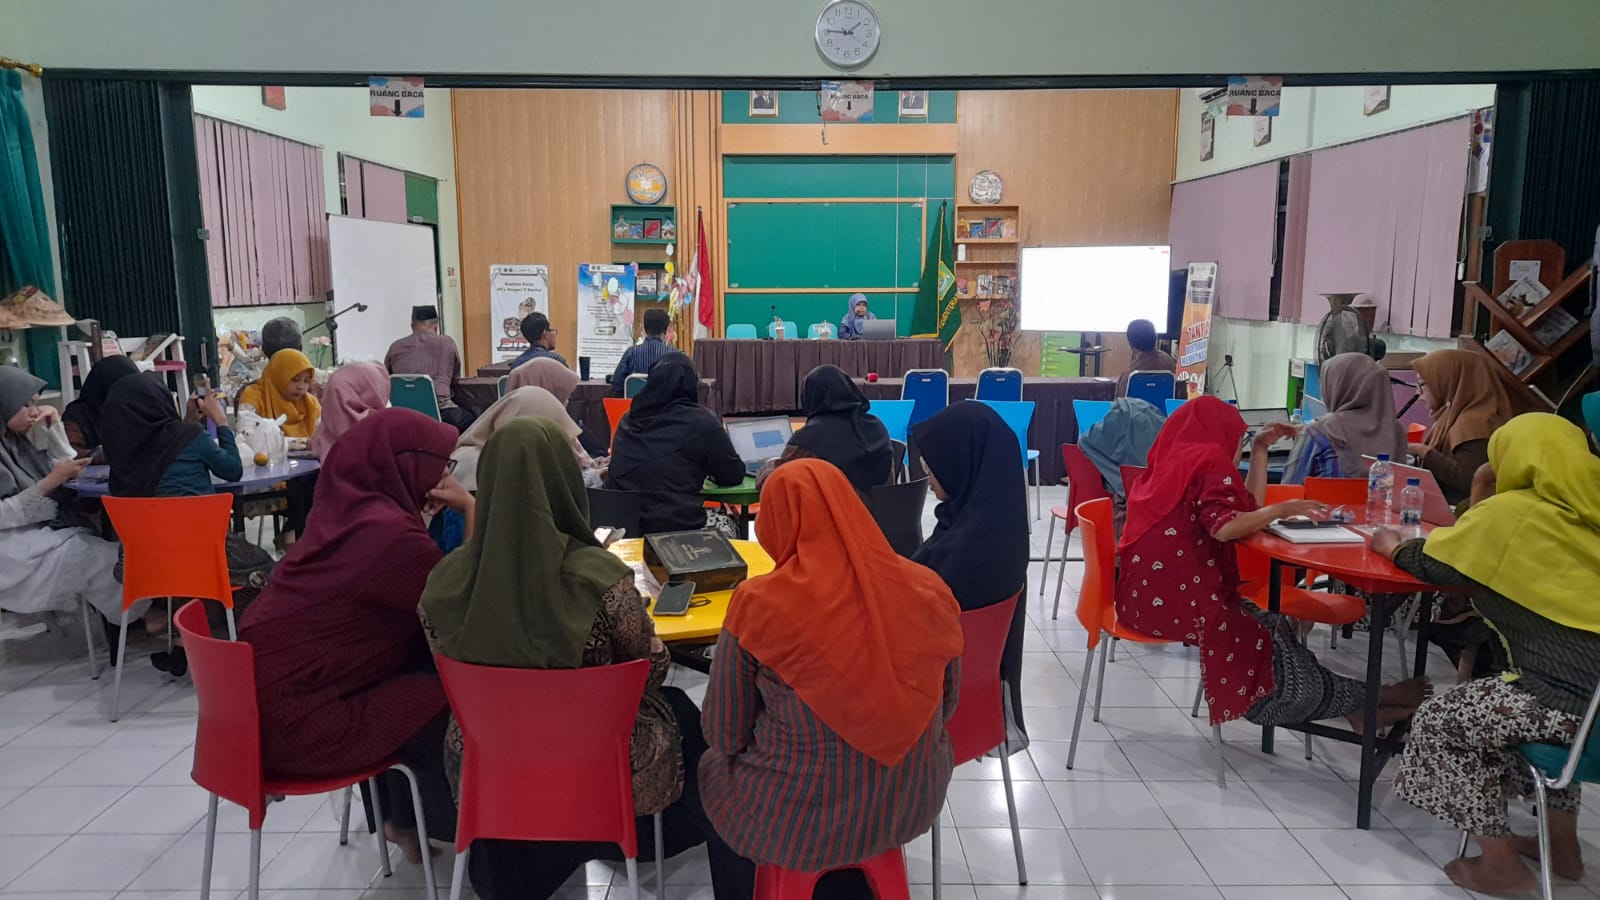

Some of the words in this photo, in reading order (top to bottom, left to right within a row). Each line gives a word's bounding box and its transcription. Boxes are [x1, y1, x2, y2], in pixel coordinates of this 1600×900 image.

[835, 8, 841, 17] 11
[845, 6, 853, 15] 12
[863, 17, 870, 26] 2
[866, 29, 872, 38] 3
[826, 39, 833, 47] 8
[862, 40, 868, 48] 4
[854, 48, 861, 56] 5
[370, 89, 399, 97] RUANG
[401, 90, 424, 98] BACA
